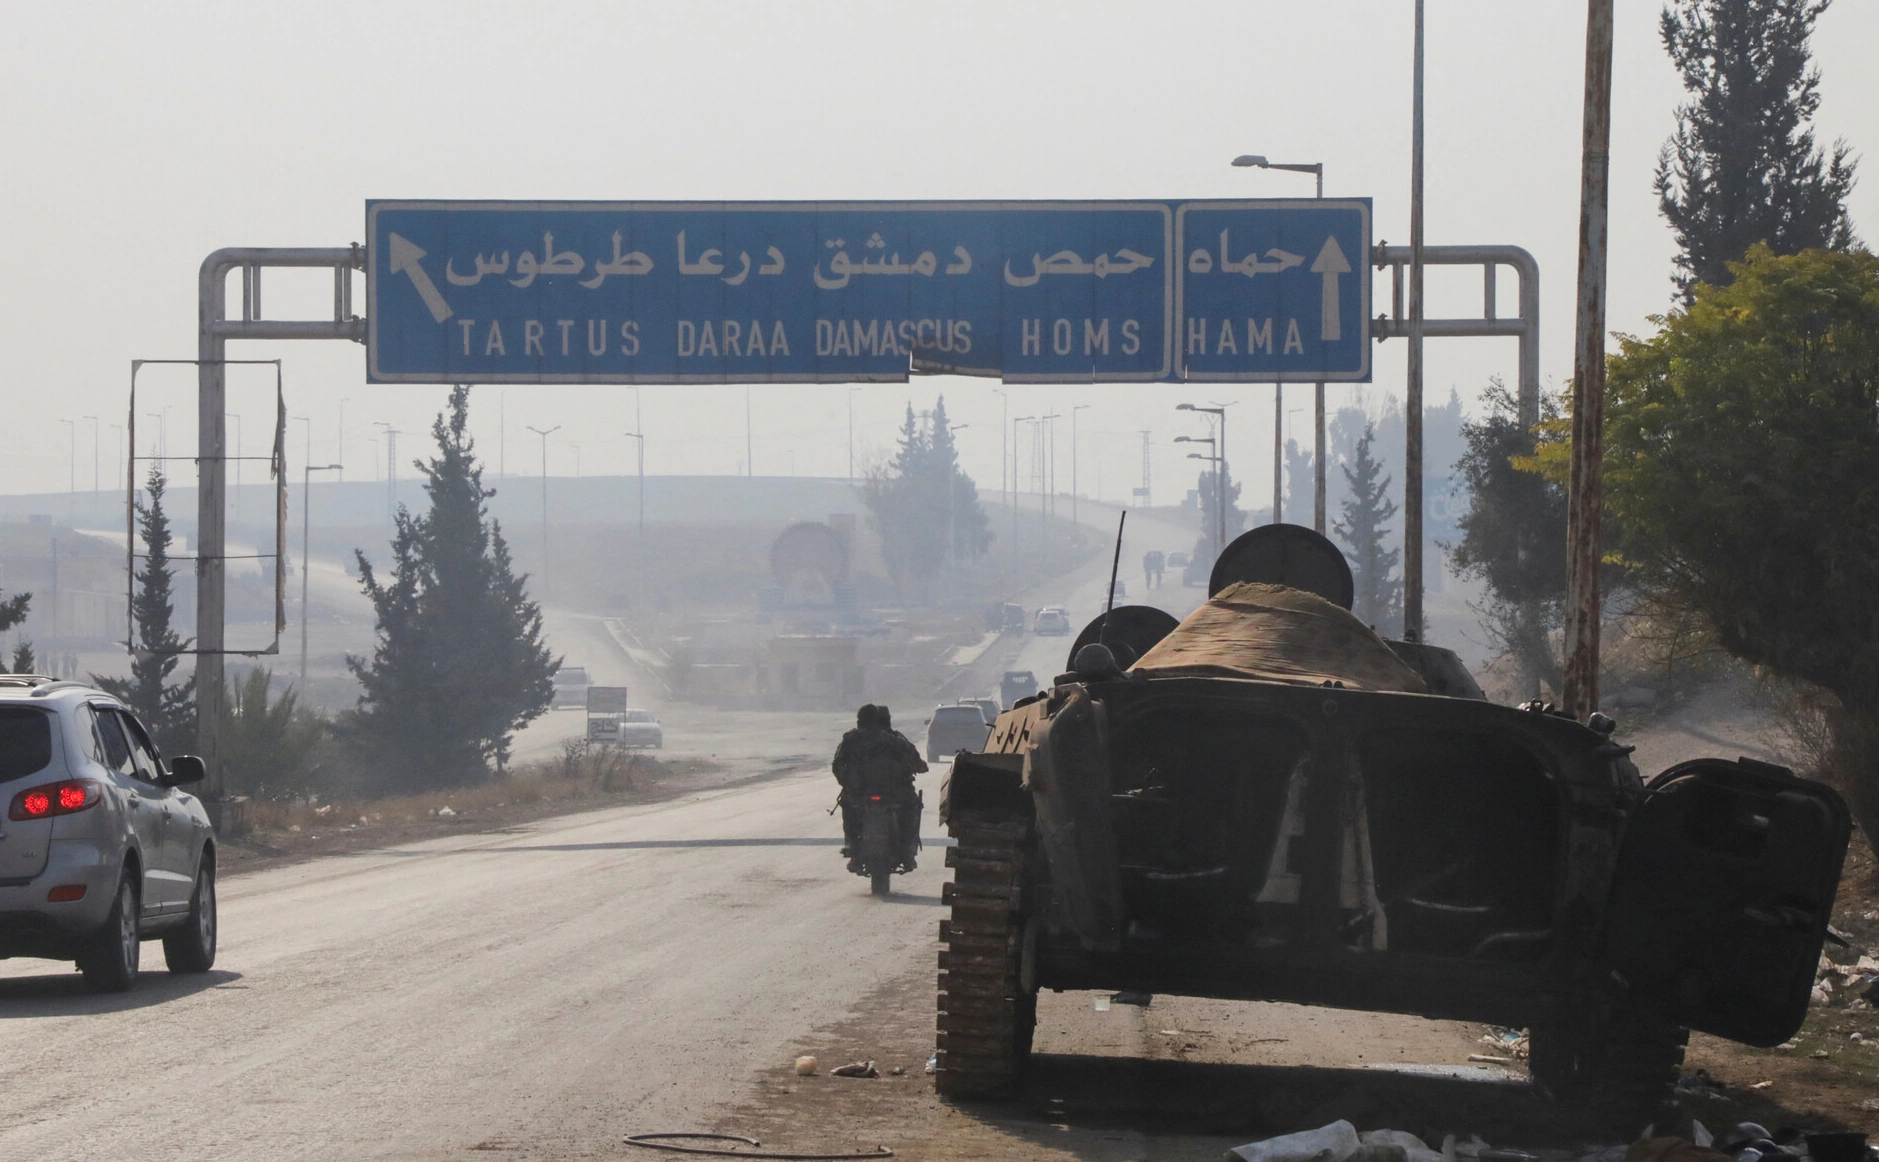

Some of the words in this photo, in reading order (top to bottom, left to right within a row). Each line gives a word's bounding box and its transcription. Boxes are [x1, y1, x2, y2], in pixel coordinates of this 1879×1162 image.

[446, 230, 655, 289] طرطوس
[677, 229, 786, 286] درعا
[813, 232, 973, 289] دمشق
[1003, 247, 1155, 287] حمص
[458, 319, 640, 357] TARTUS
[677, 319, 790, 357] DARAA
[815, 318, 972, 357] DAMASCUS
[1021, 318, 1141, 356] HOMS
[1188, 318, 1304, 355] HAMA
